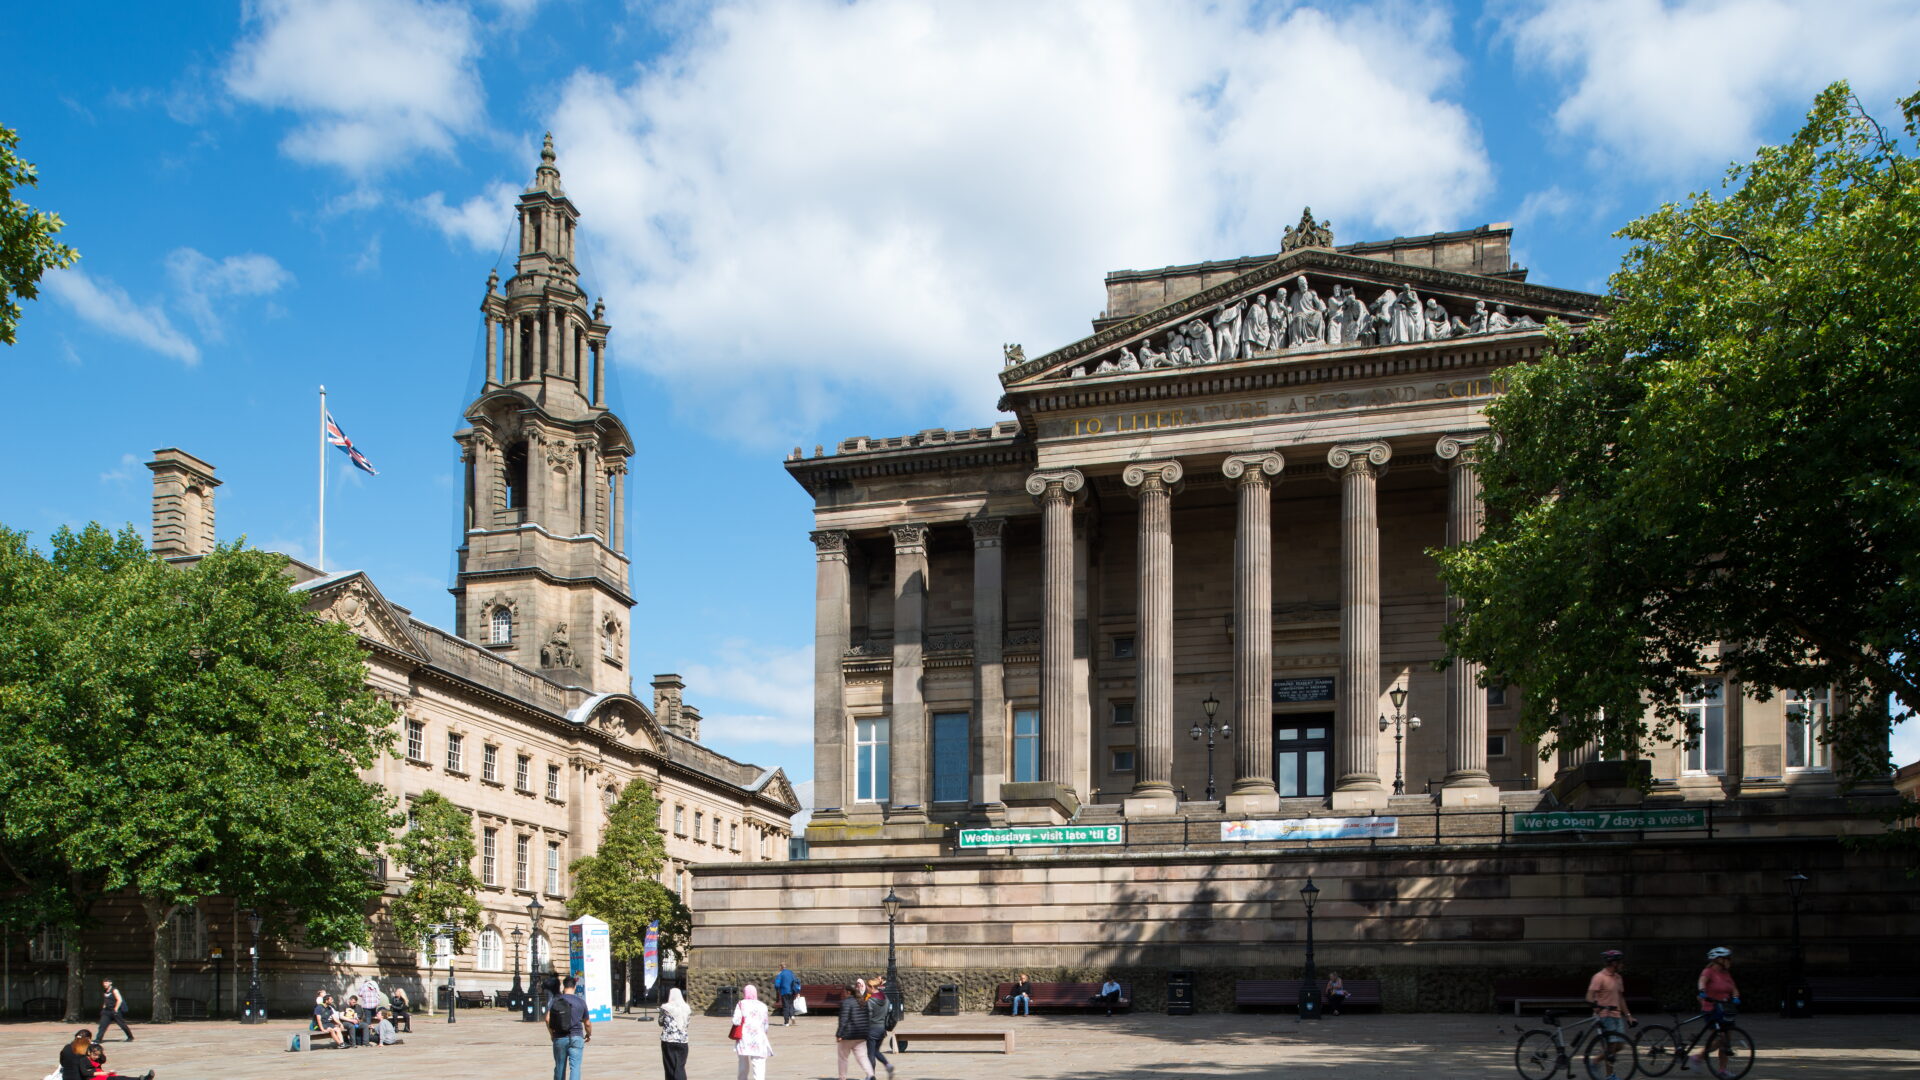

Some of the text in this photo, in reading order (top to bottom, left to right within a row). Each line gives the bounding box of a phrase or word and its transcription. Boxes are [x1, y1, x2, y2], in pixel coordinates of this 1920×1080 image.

[1072, 418, 1102, 435] TO
[1117, 401, 1268, 431] LITERATURE
[1287, 392, 1349, 413] ARTS
[1522, 813, 1696, 829] We're open 7 days a week
[964, 832, 1031, 843] Wednesdays
[1040, 830, 1063, 840] visit
[1066, 830, 1086, 840] late
[1089, 830, 1104, 839] 'til
[1106, 828, 1117, 841] 8
